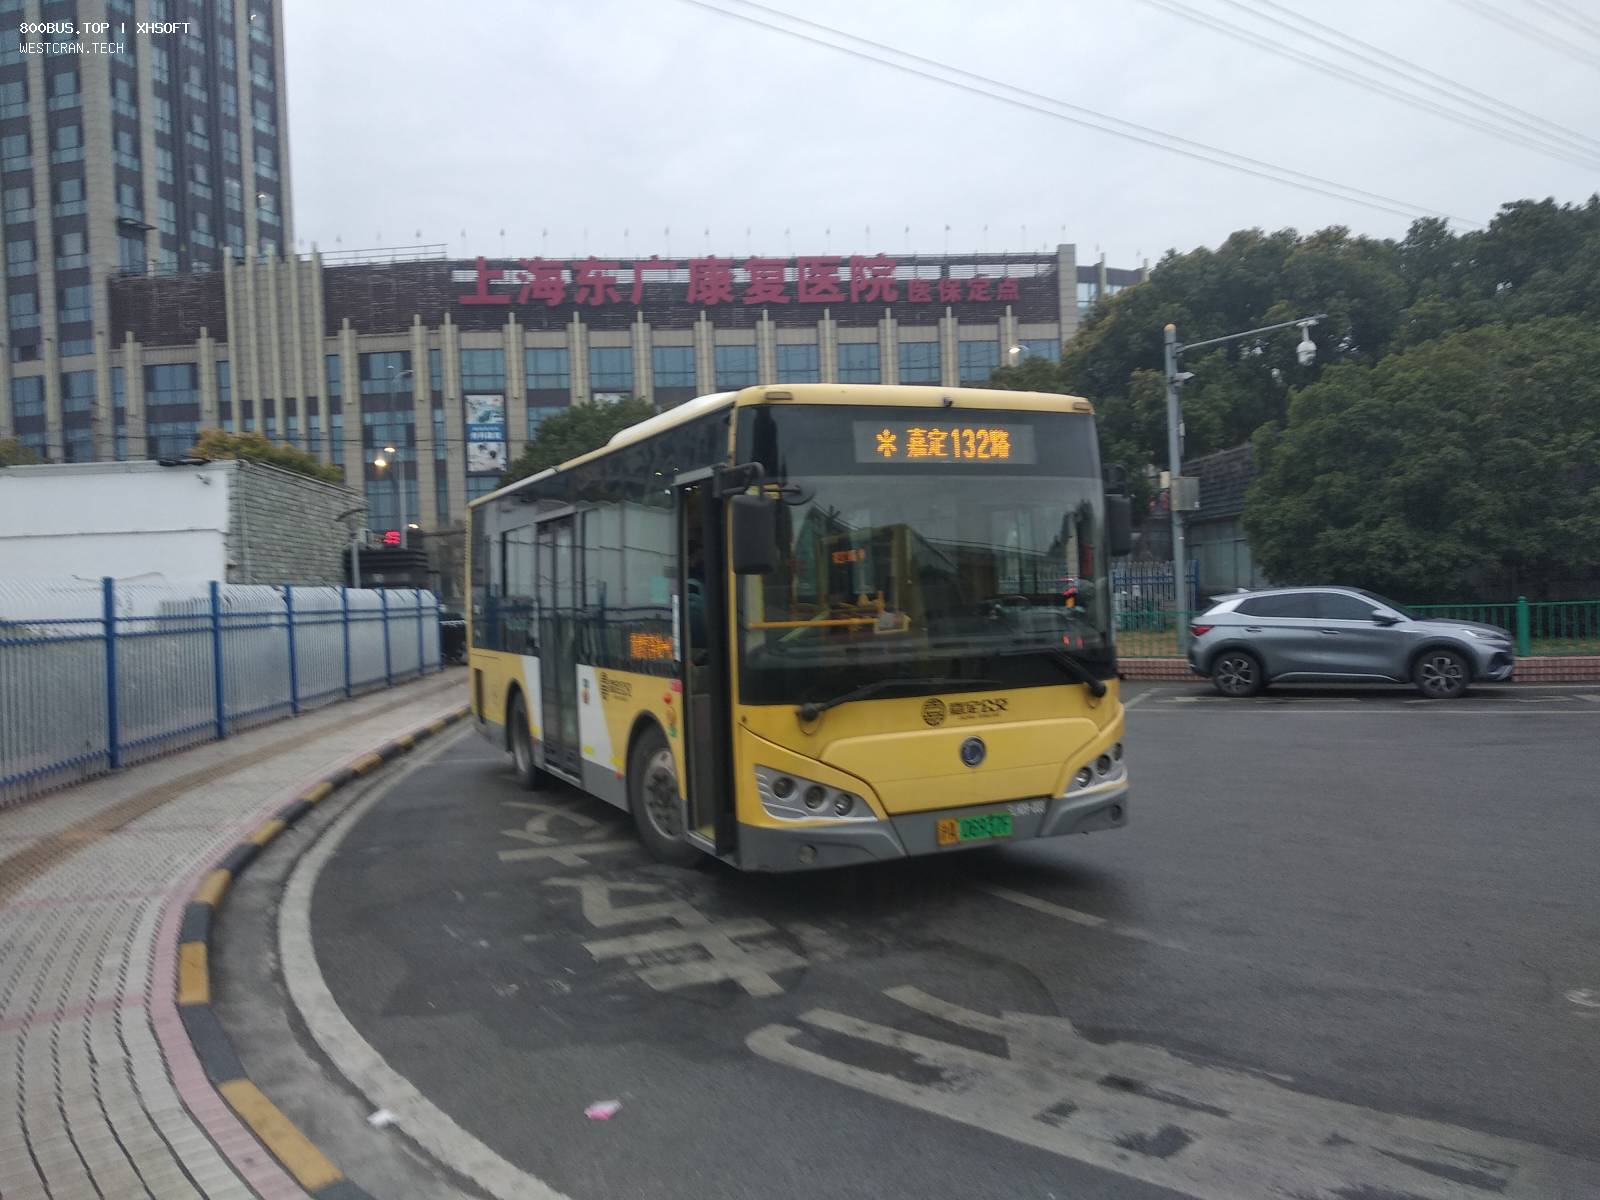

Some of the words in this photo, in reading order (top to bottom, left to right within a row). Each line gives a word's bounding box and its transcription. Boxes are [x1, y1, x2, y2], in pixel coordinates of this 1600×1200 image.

[458, 255, 898, 305] 上海东广康复医院
[907, 276, 1021, 303] 医保定点
